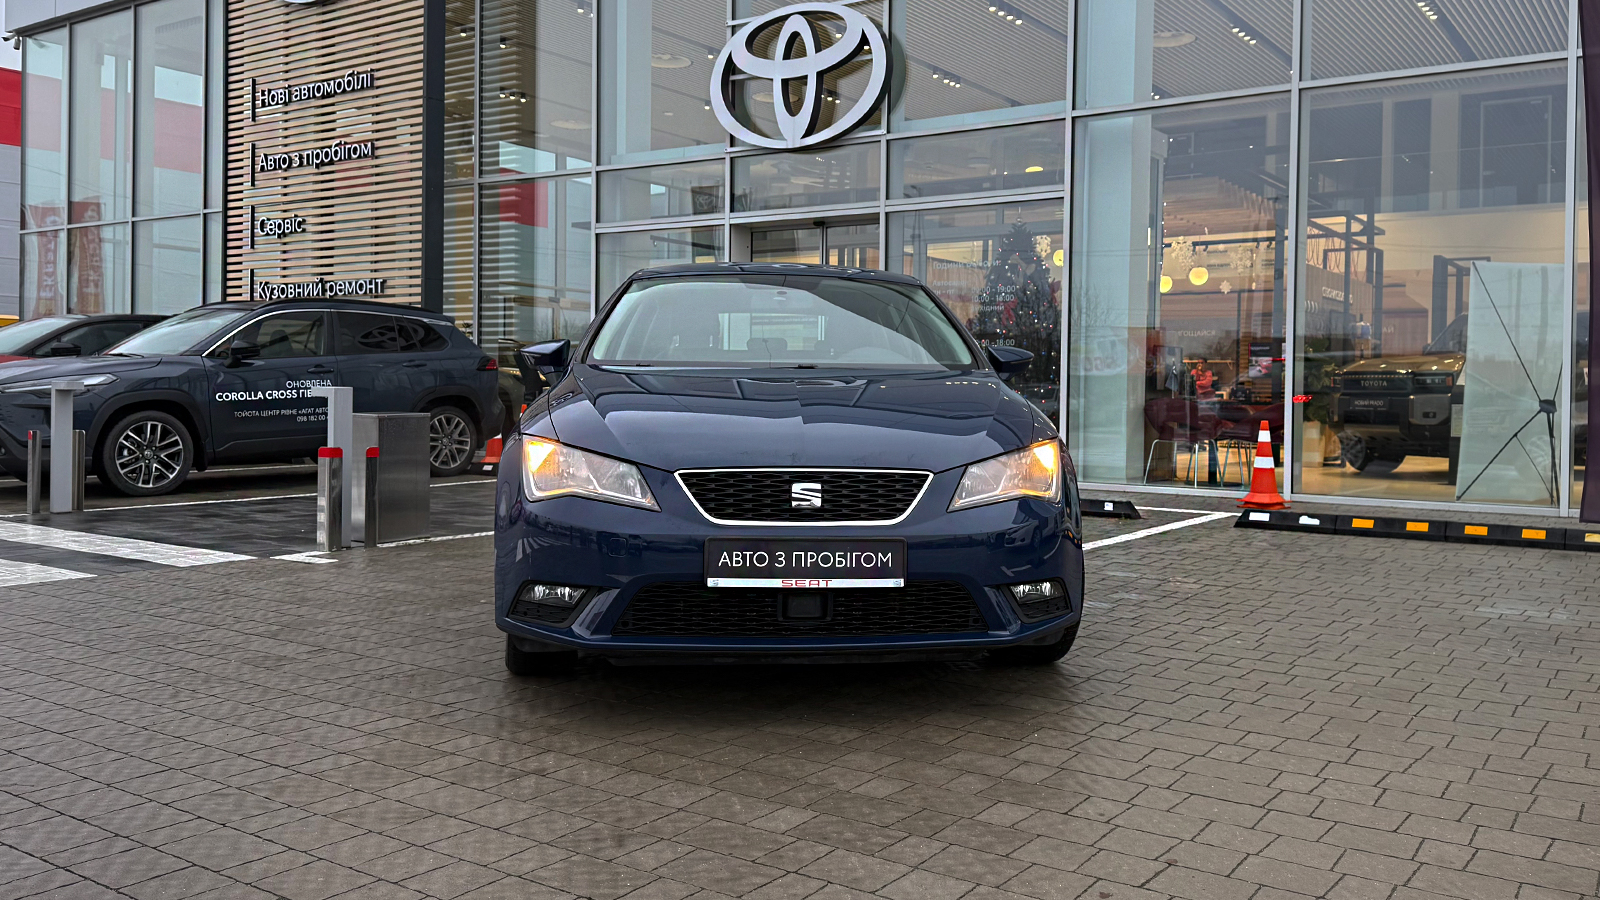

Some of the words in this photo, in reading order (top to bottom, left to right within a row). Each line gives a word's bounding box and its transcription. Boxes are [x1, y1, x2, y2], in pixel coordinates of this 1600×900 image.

[259, 83, 290, 107] Нові
[292, 68, 373, 100] автомобілі
[258, 153, 289, 172] Авто
[293, 152, 301, 168] з
[304, 140, 372, 170] пробігом
[257, 213, 304, 239] Сервіс
[257, 276, 322, 301] Кузовний
[327, 279, 384, 299] ремонт
[997, 285, 1016, 293] 19:00
[286, 379, 333, 389] ОНОВЛЕНА
[215, 389, 264, 402] COROLLA
[266, 389, 298, 400] CROSS
[234, 410, 260, 418] ТОЙОТА
[260, 409, 280, 418] ЦЕНТР
[718, 551, 769, 568] АВТО
[774, 551, 786, 568] З
[792, 551, 892, 568] ПРОБІГОМ
[781, 579, 833, 588] SEAT
